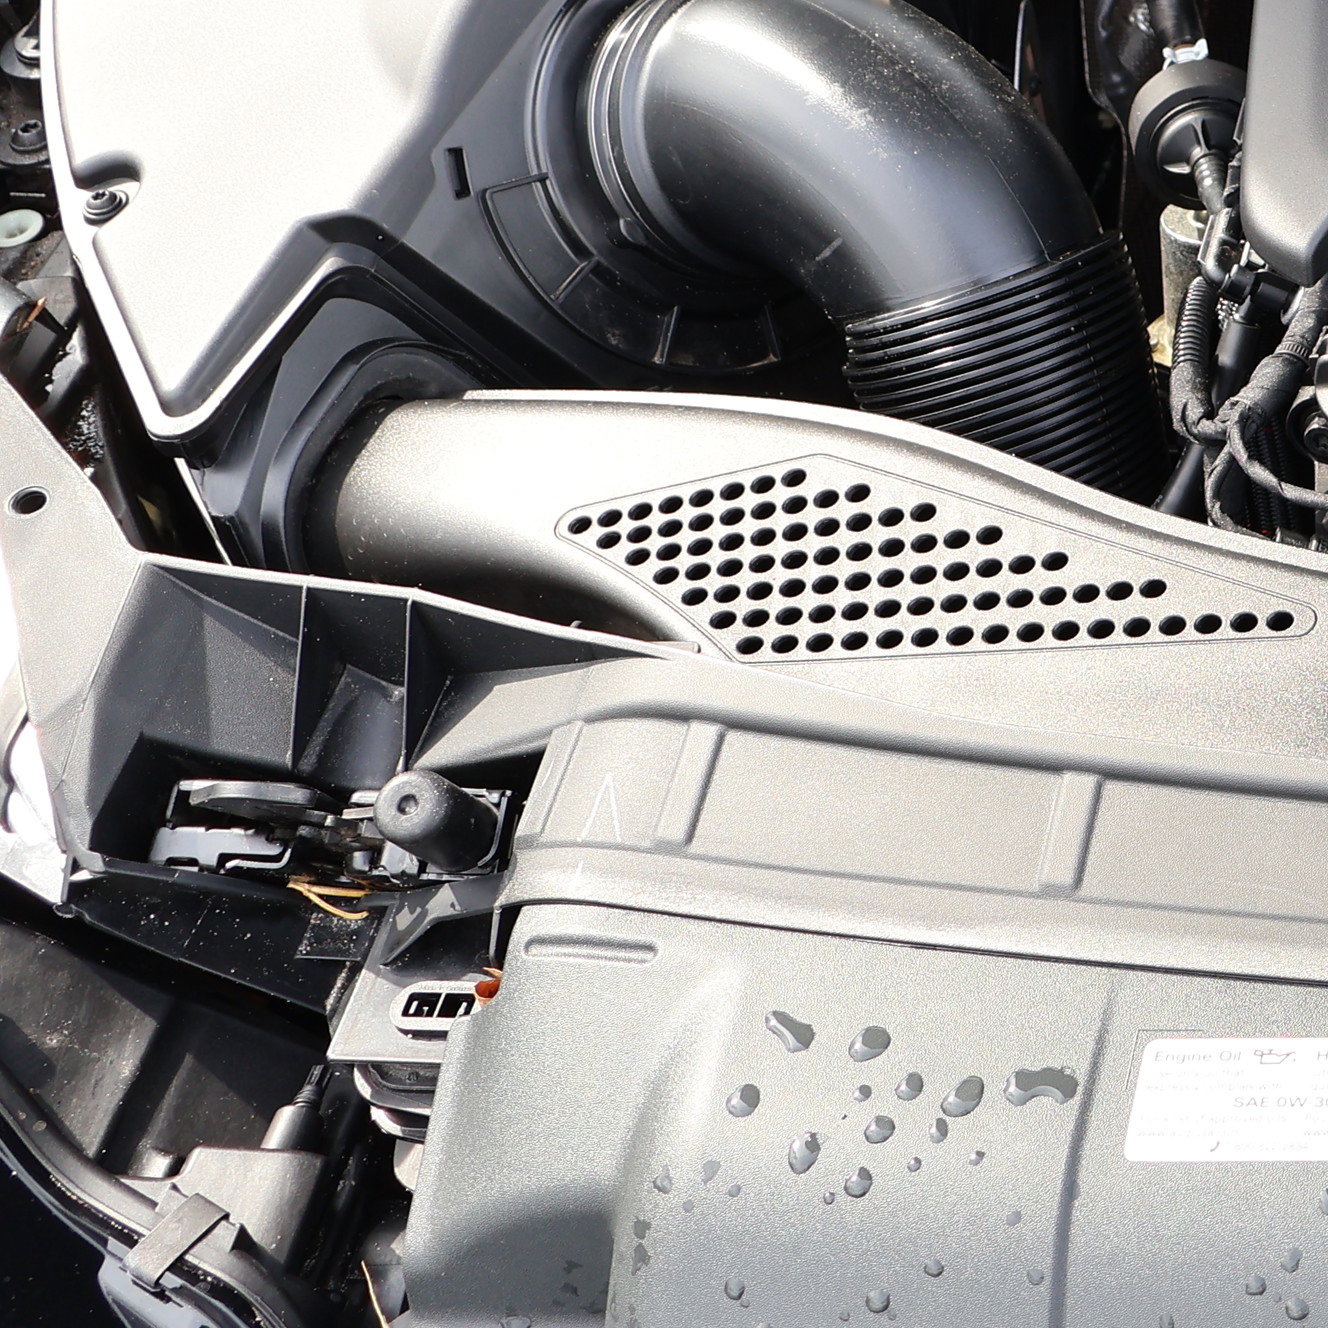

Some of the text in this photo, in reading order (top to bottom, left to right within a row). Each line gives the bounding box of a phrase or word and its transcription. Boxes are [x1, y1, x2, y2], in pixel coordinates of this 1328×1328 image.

[1154, 1050, 1212, 1064] Engine
[1219, 1050, 1242, 1062] Oil
[1233, 1096, 1269, 1108] SAE
